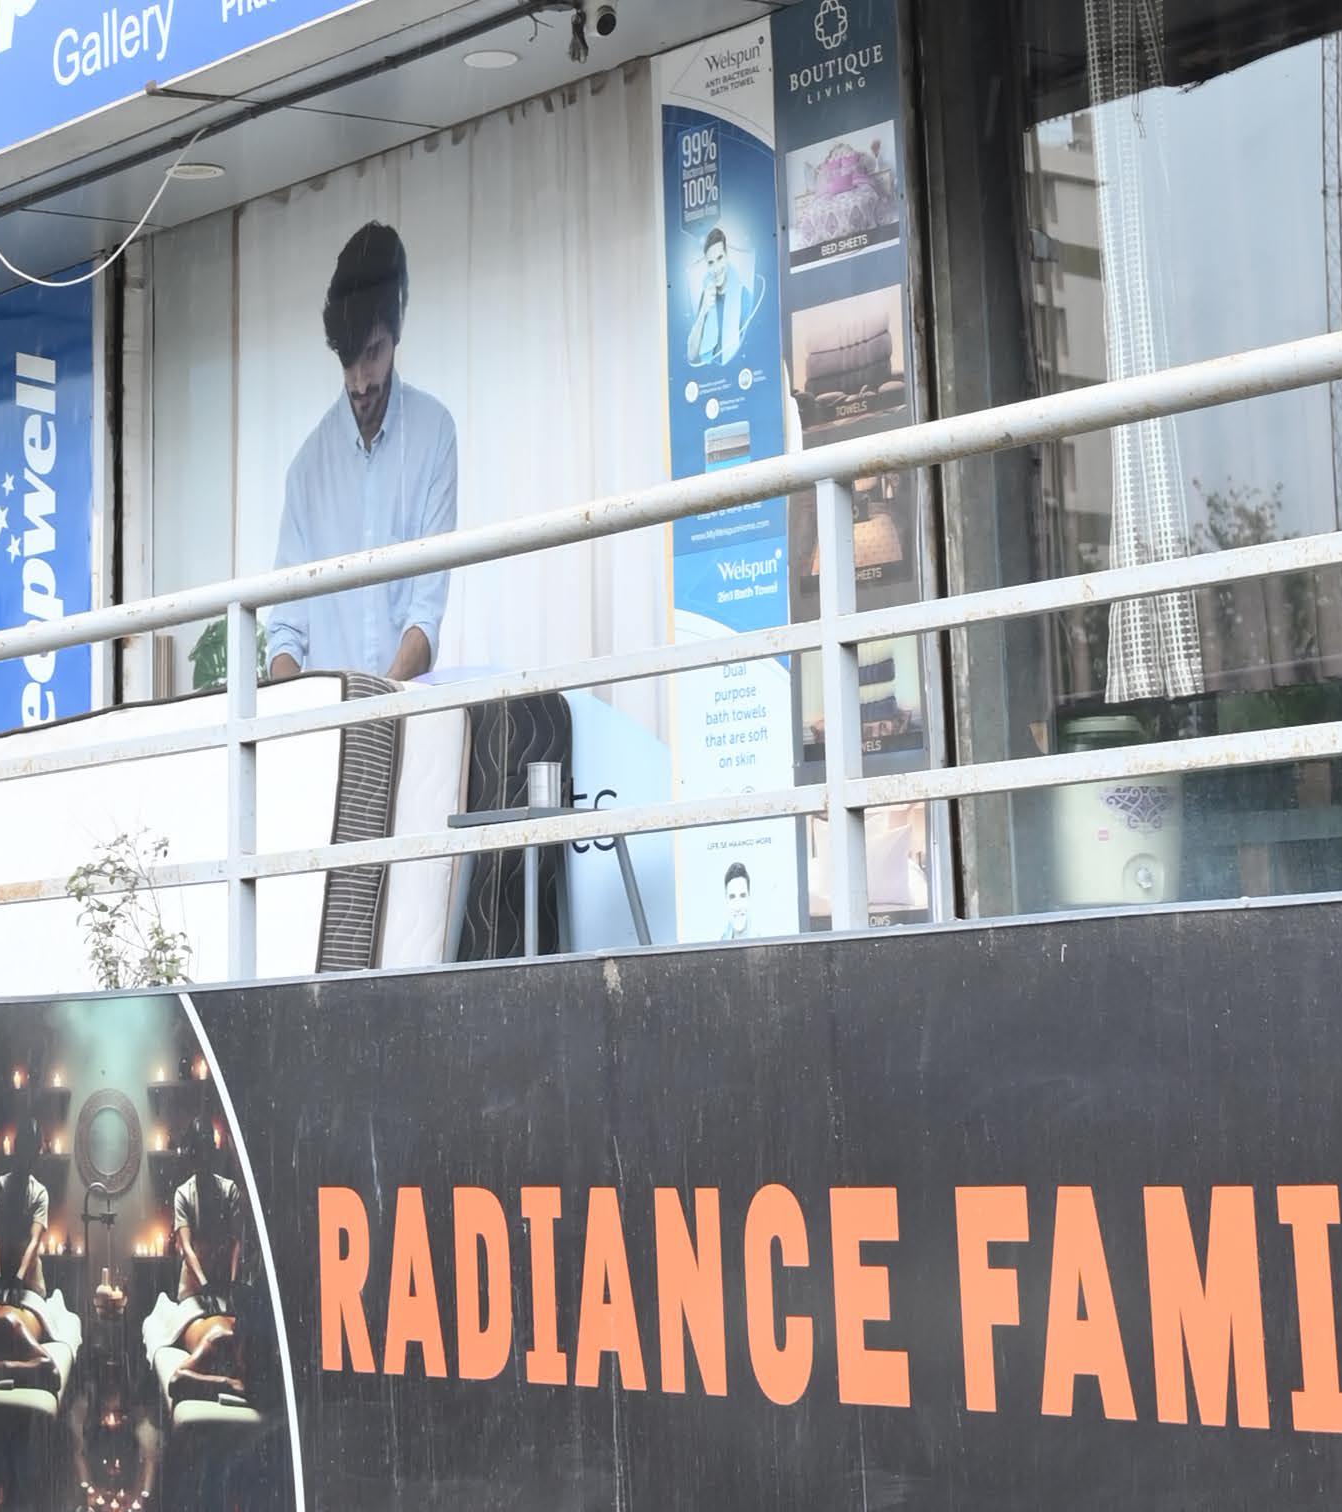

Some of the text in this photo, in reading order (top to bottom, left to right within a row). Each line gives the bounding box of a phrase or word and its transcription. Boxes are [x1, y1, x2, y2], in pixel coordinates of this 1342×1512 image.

[53, 0, 174, 88] Gallery
[705, 46, 760, 73] Welspun
[789, 44, 885, 92] BOUTIQUE
[807, 77, 866, 104] LIVING
[681, 127, 717, 168] 99%
[683, 174, 719, 209] 100%
[820, 234, 868, 256] BED SHEETS
[835, 401, 868, 417] TOWELS
[717, 557, 778, 583] Welspun
[755, 582, 778, 596] Towel
[723, 662, 747, 678] Dual
[714, 685, 757, 704] purpose
[705, 704, 767, 726] bath towels
[705, 727, 769, 748] that are soft
[719, 752, 756, 769] on skin
[317, 1184, 912, 1409] RADIANCE
